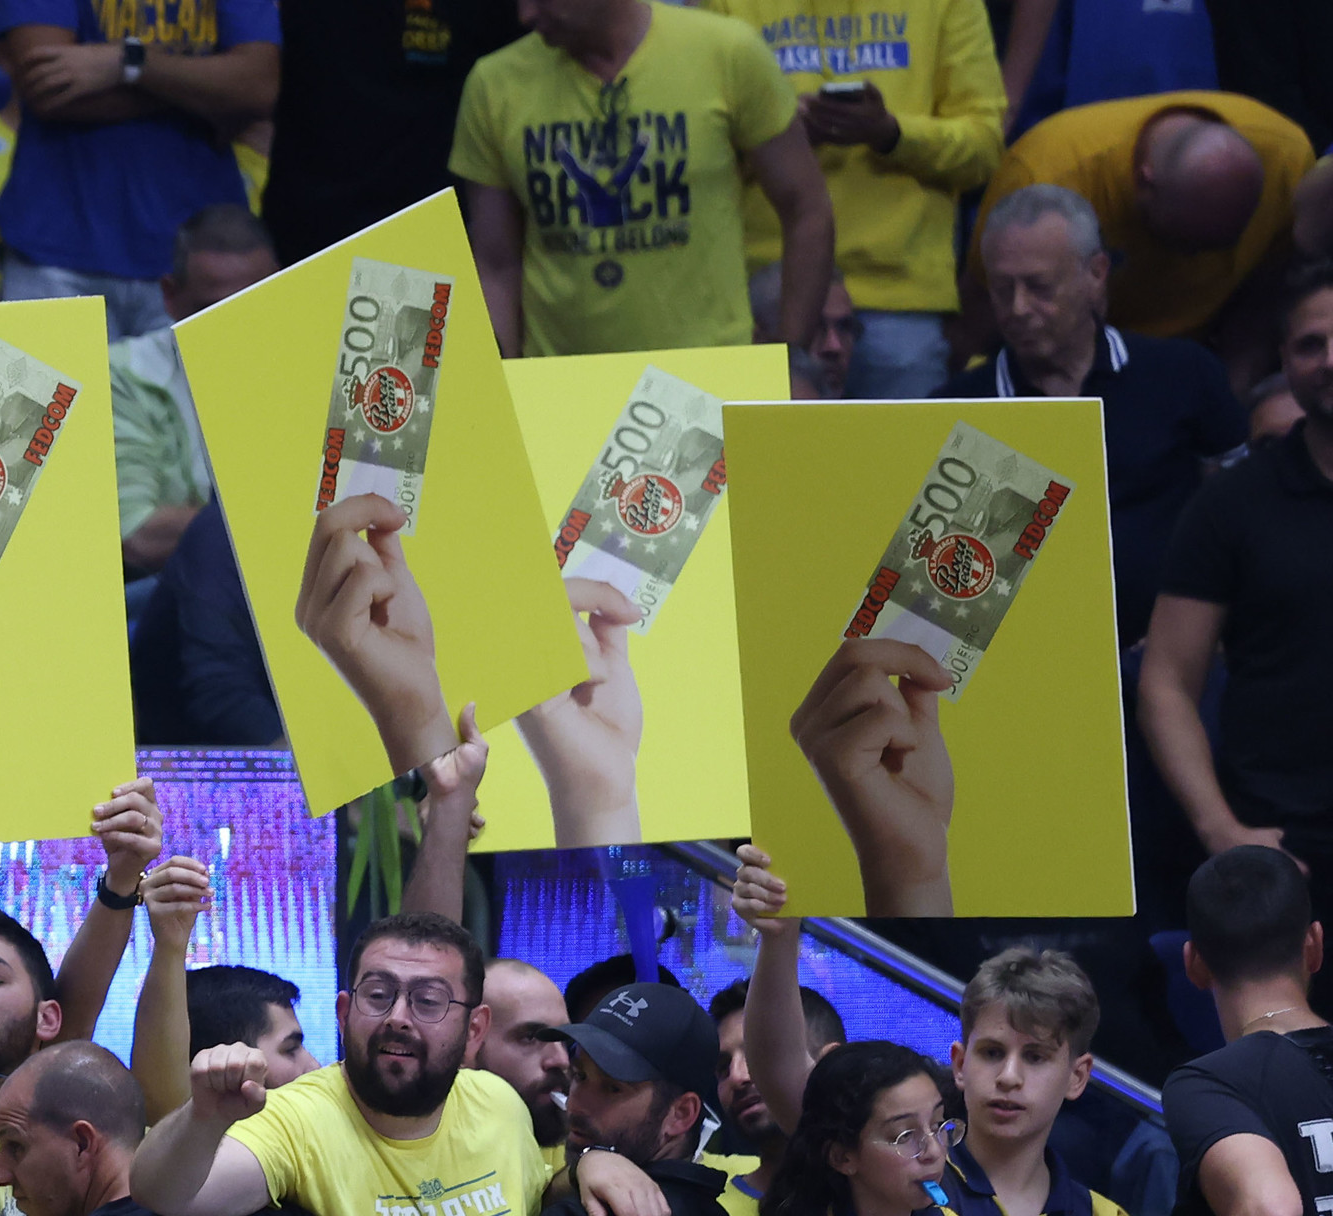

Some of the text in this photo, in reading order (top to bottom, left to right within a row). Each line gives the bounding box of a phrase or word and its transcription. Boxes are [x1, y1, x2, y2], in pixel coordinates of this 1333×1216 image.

[340, 295, 381, 379] 500
[422, 282, 453, 370] FEDCOM
[23, 382, 78, 467] FEDCOM
[600, 400, 667, 476] 500
[909, 456, 977, 538] 500
[1013, 480, 1071, 560] FEDCOM
